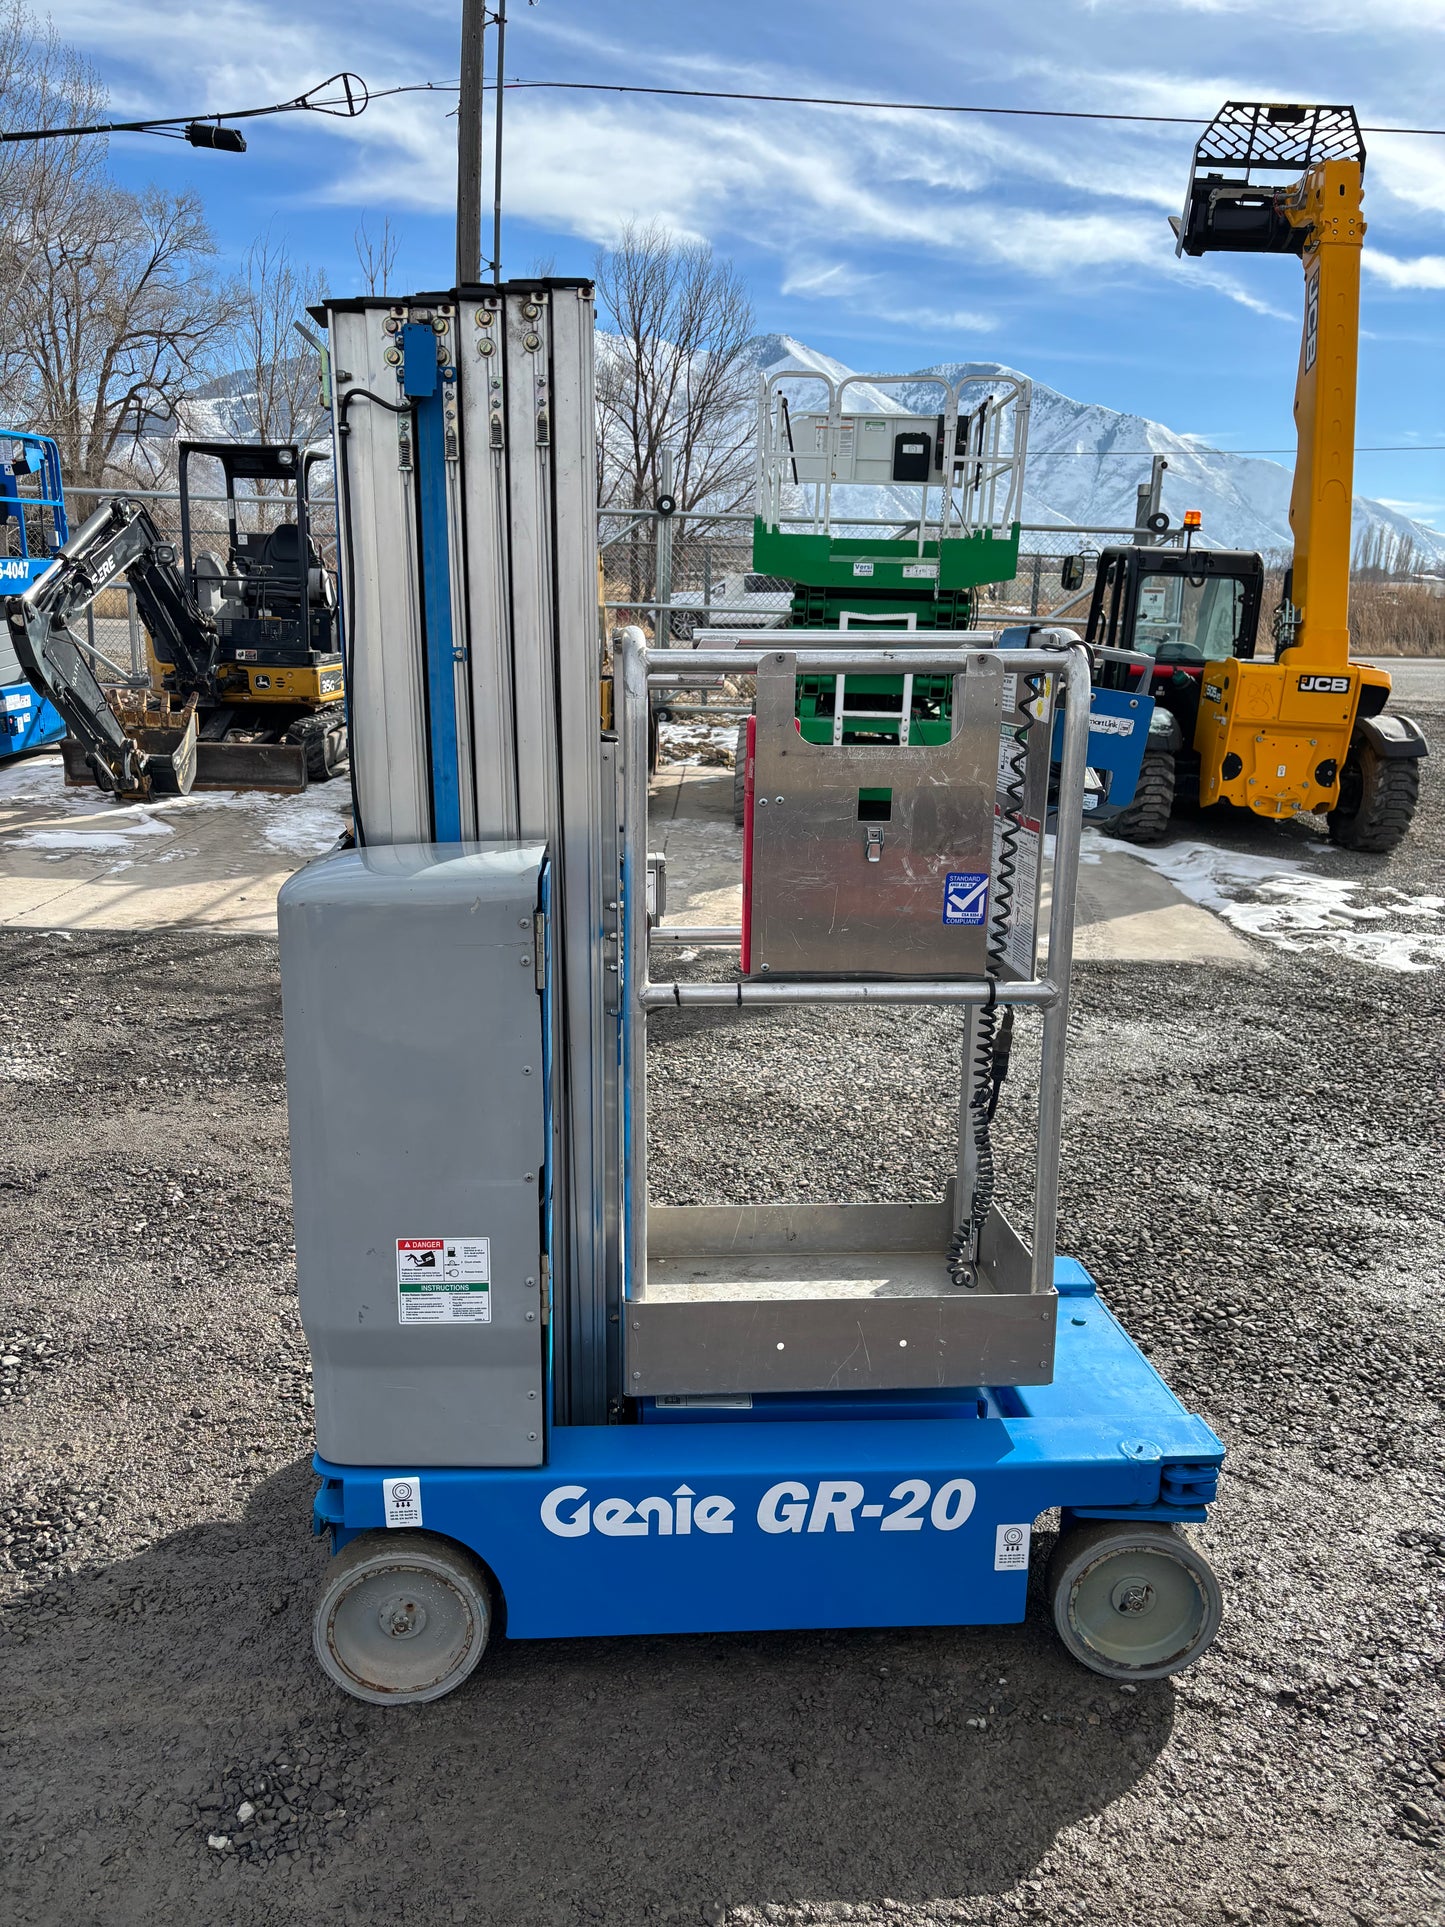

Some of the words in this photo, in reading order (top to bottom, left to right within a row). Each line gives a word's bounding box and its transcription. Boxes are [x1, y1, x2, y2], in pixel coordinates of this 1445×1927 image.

[1307, 279, 1318, 371] JCB
[322, 680, 335, 692] 35G
[1301, 677, 1348, 691] JCB
[412, 1241, 441, 1249] DANGER
[540, 1483, 736, 1538] Genie
[757, 1479, 976, 1534] GR-20
